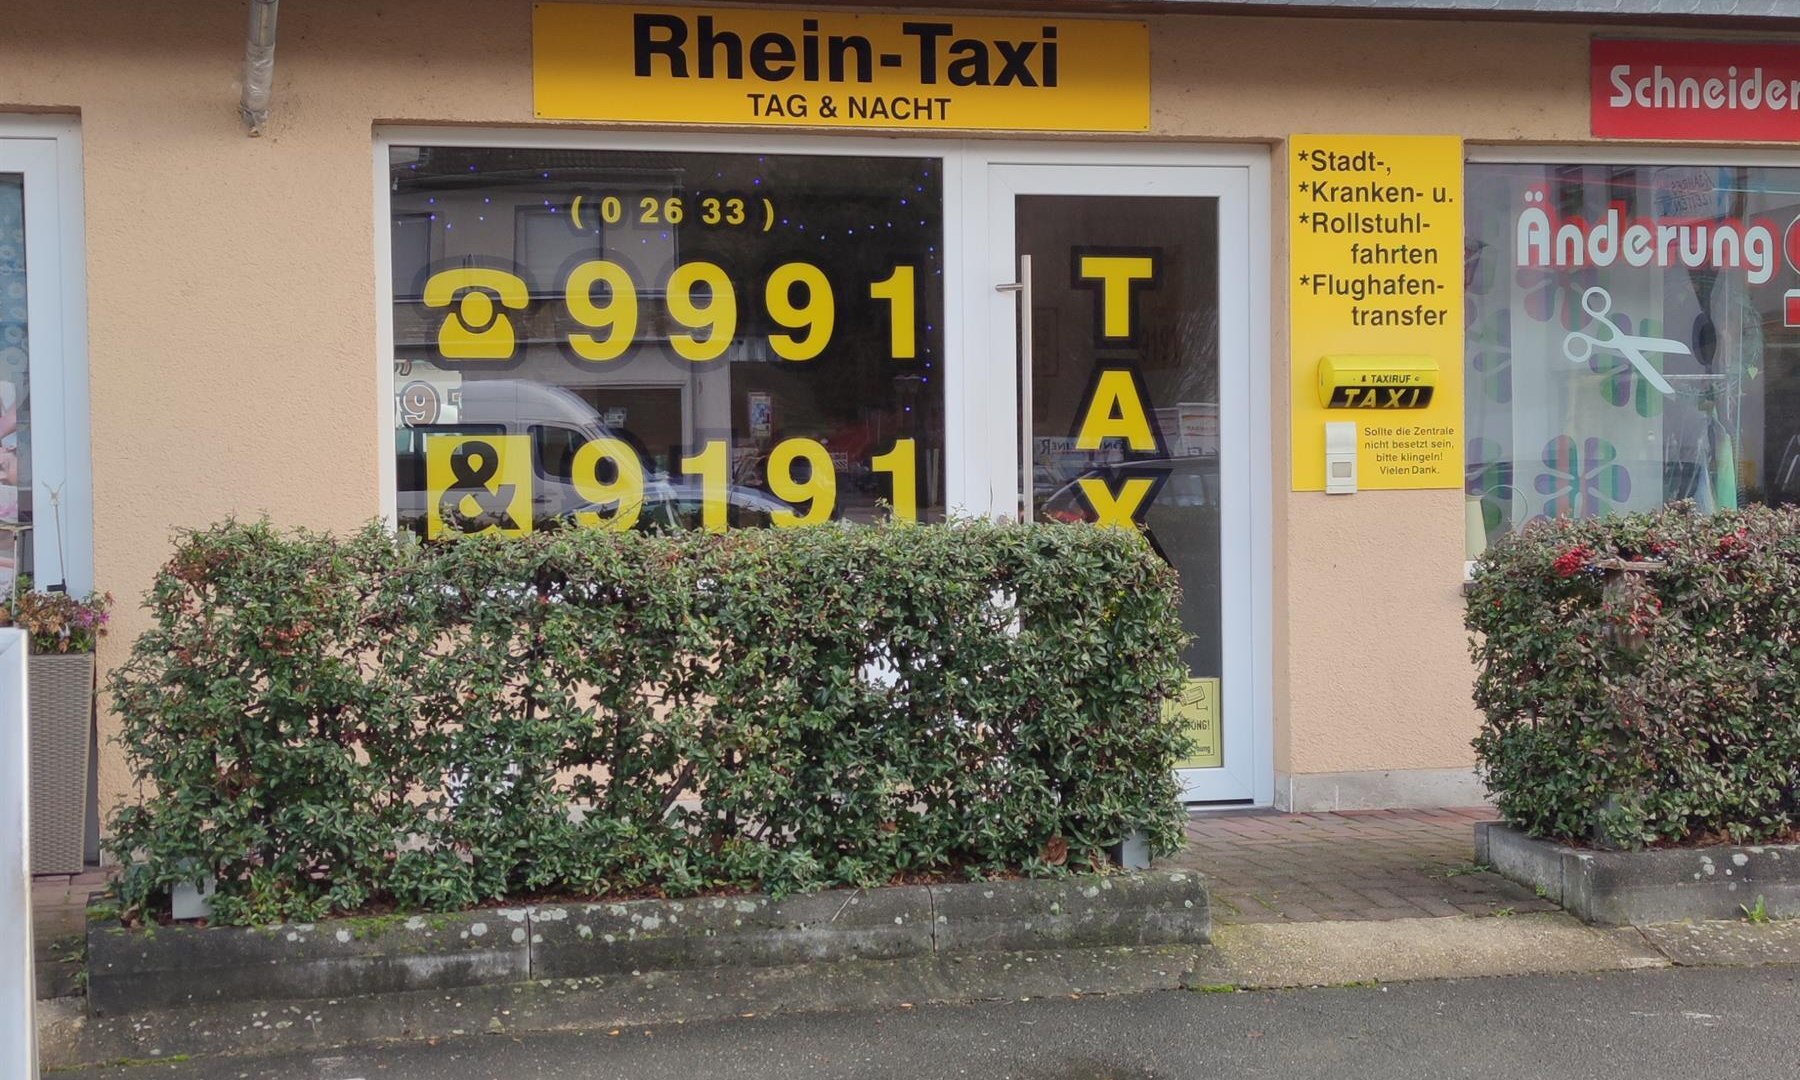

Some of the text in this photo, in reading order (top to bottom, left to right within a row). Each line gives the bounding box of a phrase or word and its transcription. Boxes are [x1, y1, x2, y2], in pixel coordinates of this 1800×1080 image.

[634, 14, 1058, 88] Rhein-Taxi
[1610, 64, 1800, 110] Schneider
[747, 93, 951, 121] TAG & NACHT
[1433, 186, 1453, 203] u.
[640, 197, 683, 224] 26
[702, 198, 745, 225] 33
[1517, 190, 1774, 284] Änderung
[1350, 243, 1438, 264] fahrten
[565, 260, 917, 362] 9991
[1351, 305, 1448, 326] transfer
[1370, 374, 1412, 384] TAXIRUF
[1075, 257, 1156, 529] TAX
[1344, 388, 1420, 408] TAXI
[1364, 426, 1455, 436] Sollte die Zentrale
[1364, 439, 1454, 449] nicht besetzt sein,
[1376, 452, 1443, 463] bitte klingeln!
[1380, 465, 1440, 475] Vielen Dank.
[572, 438, 917, 535] 9191
